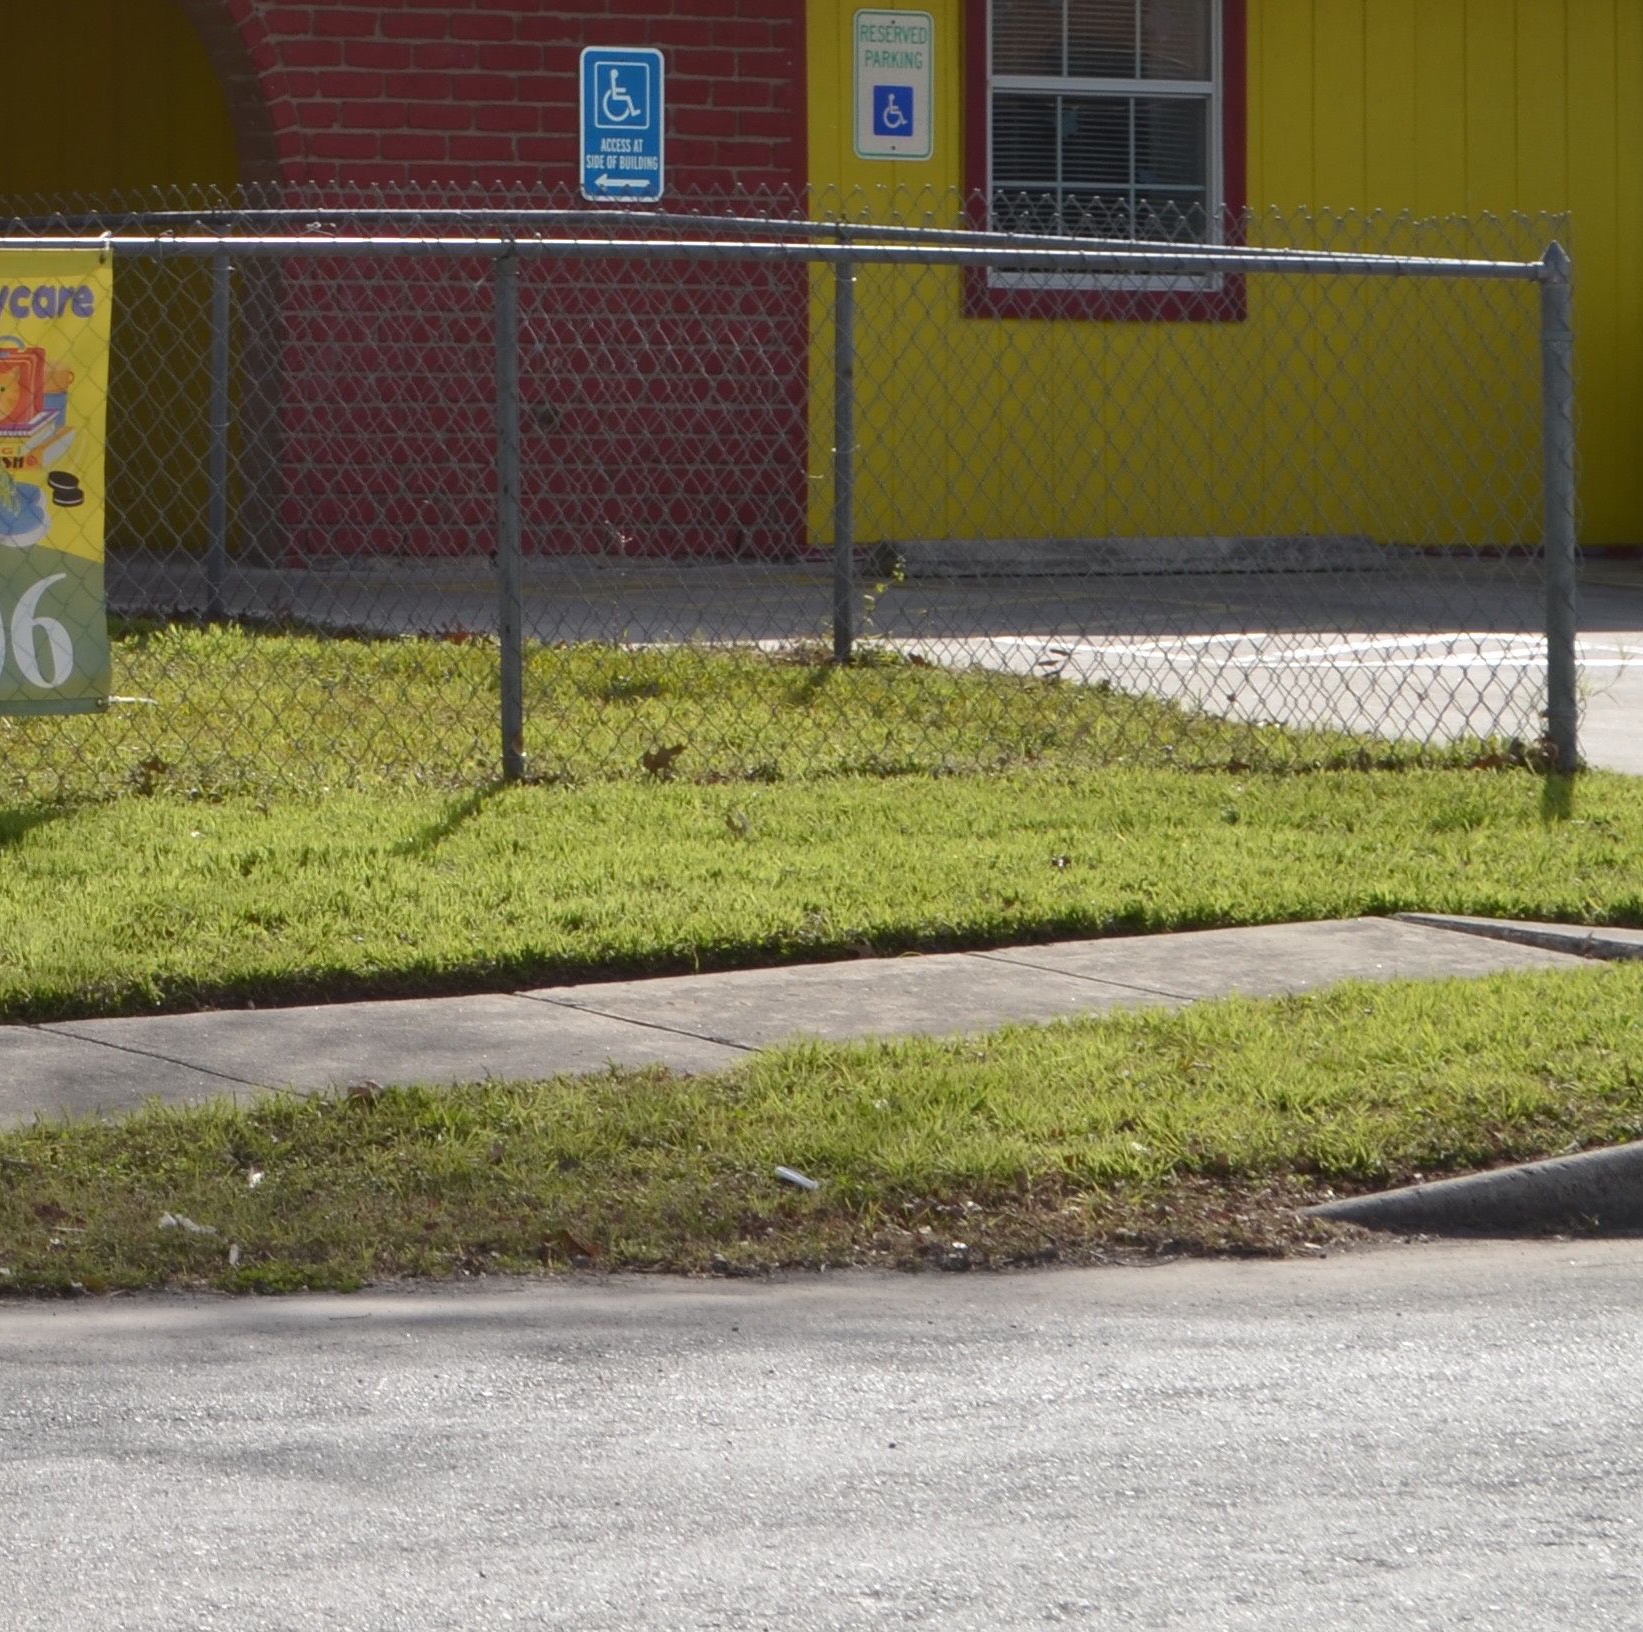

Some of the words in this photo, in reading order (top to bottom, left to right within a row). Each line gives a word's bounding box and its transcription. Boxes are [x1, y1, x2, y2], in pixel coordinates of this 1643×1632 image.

[859, 24, 928, 45] RESERVED
[865, 49, 924, 70] PARKING
[600, 137, 632, 153] ACCESS
[632, 138, 644, 153] AT
[586, 154, 605, 169] SIDE
[606, 155, 618, 169] OF
[619, 155, 659, 171] BUILDING
